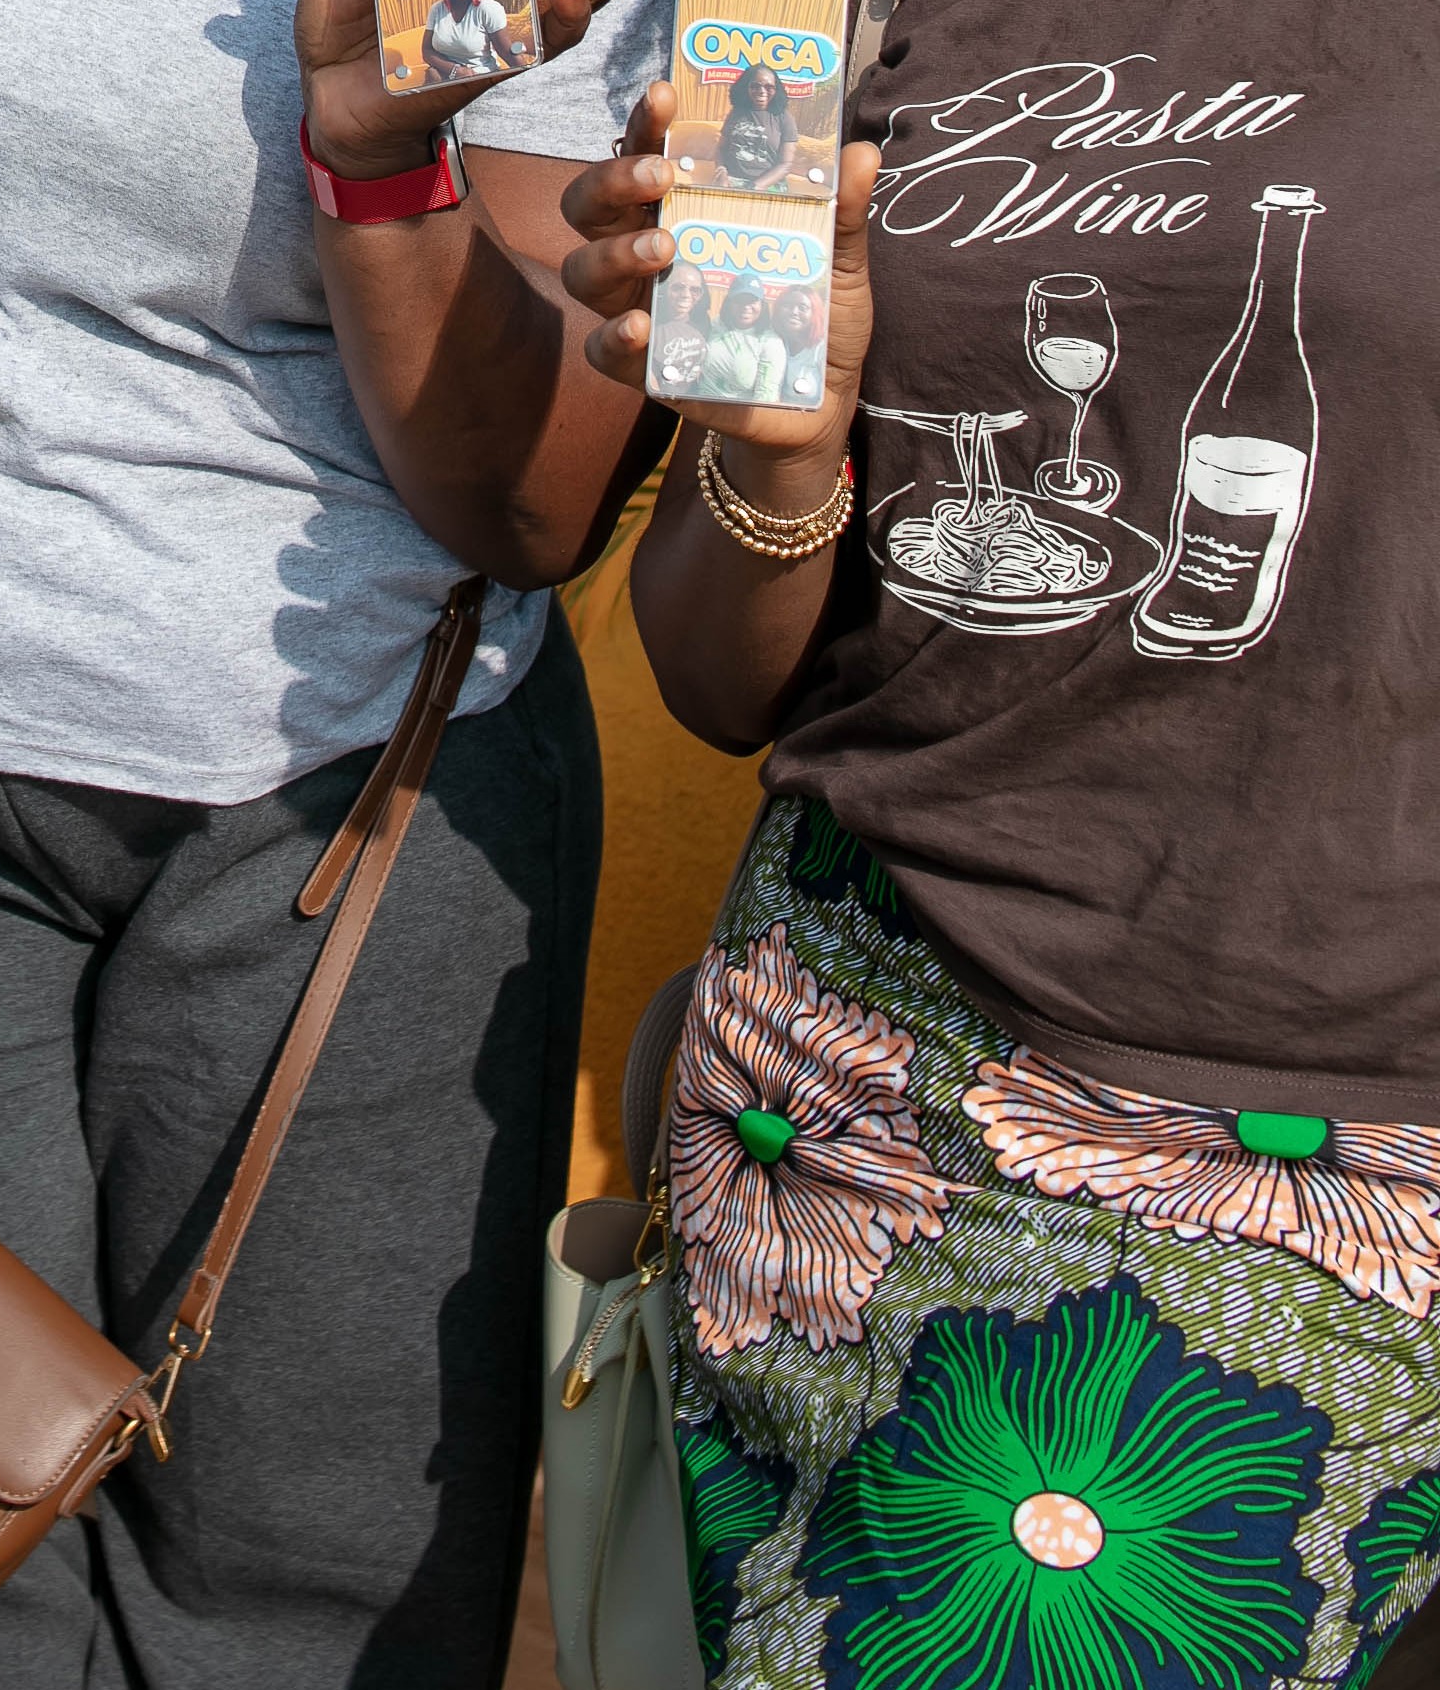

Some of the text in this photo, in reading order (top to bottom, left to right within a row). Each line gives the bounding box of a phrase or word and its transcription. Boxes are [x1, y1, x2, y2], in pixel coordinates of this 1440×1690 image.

[693, 26, 824, 75] ONGA
[877, 54, 1306, 173] Pasta
[882, 156, 1212, 248] Wine
[678, 226, 810, 277] ONGA
